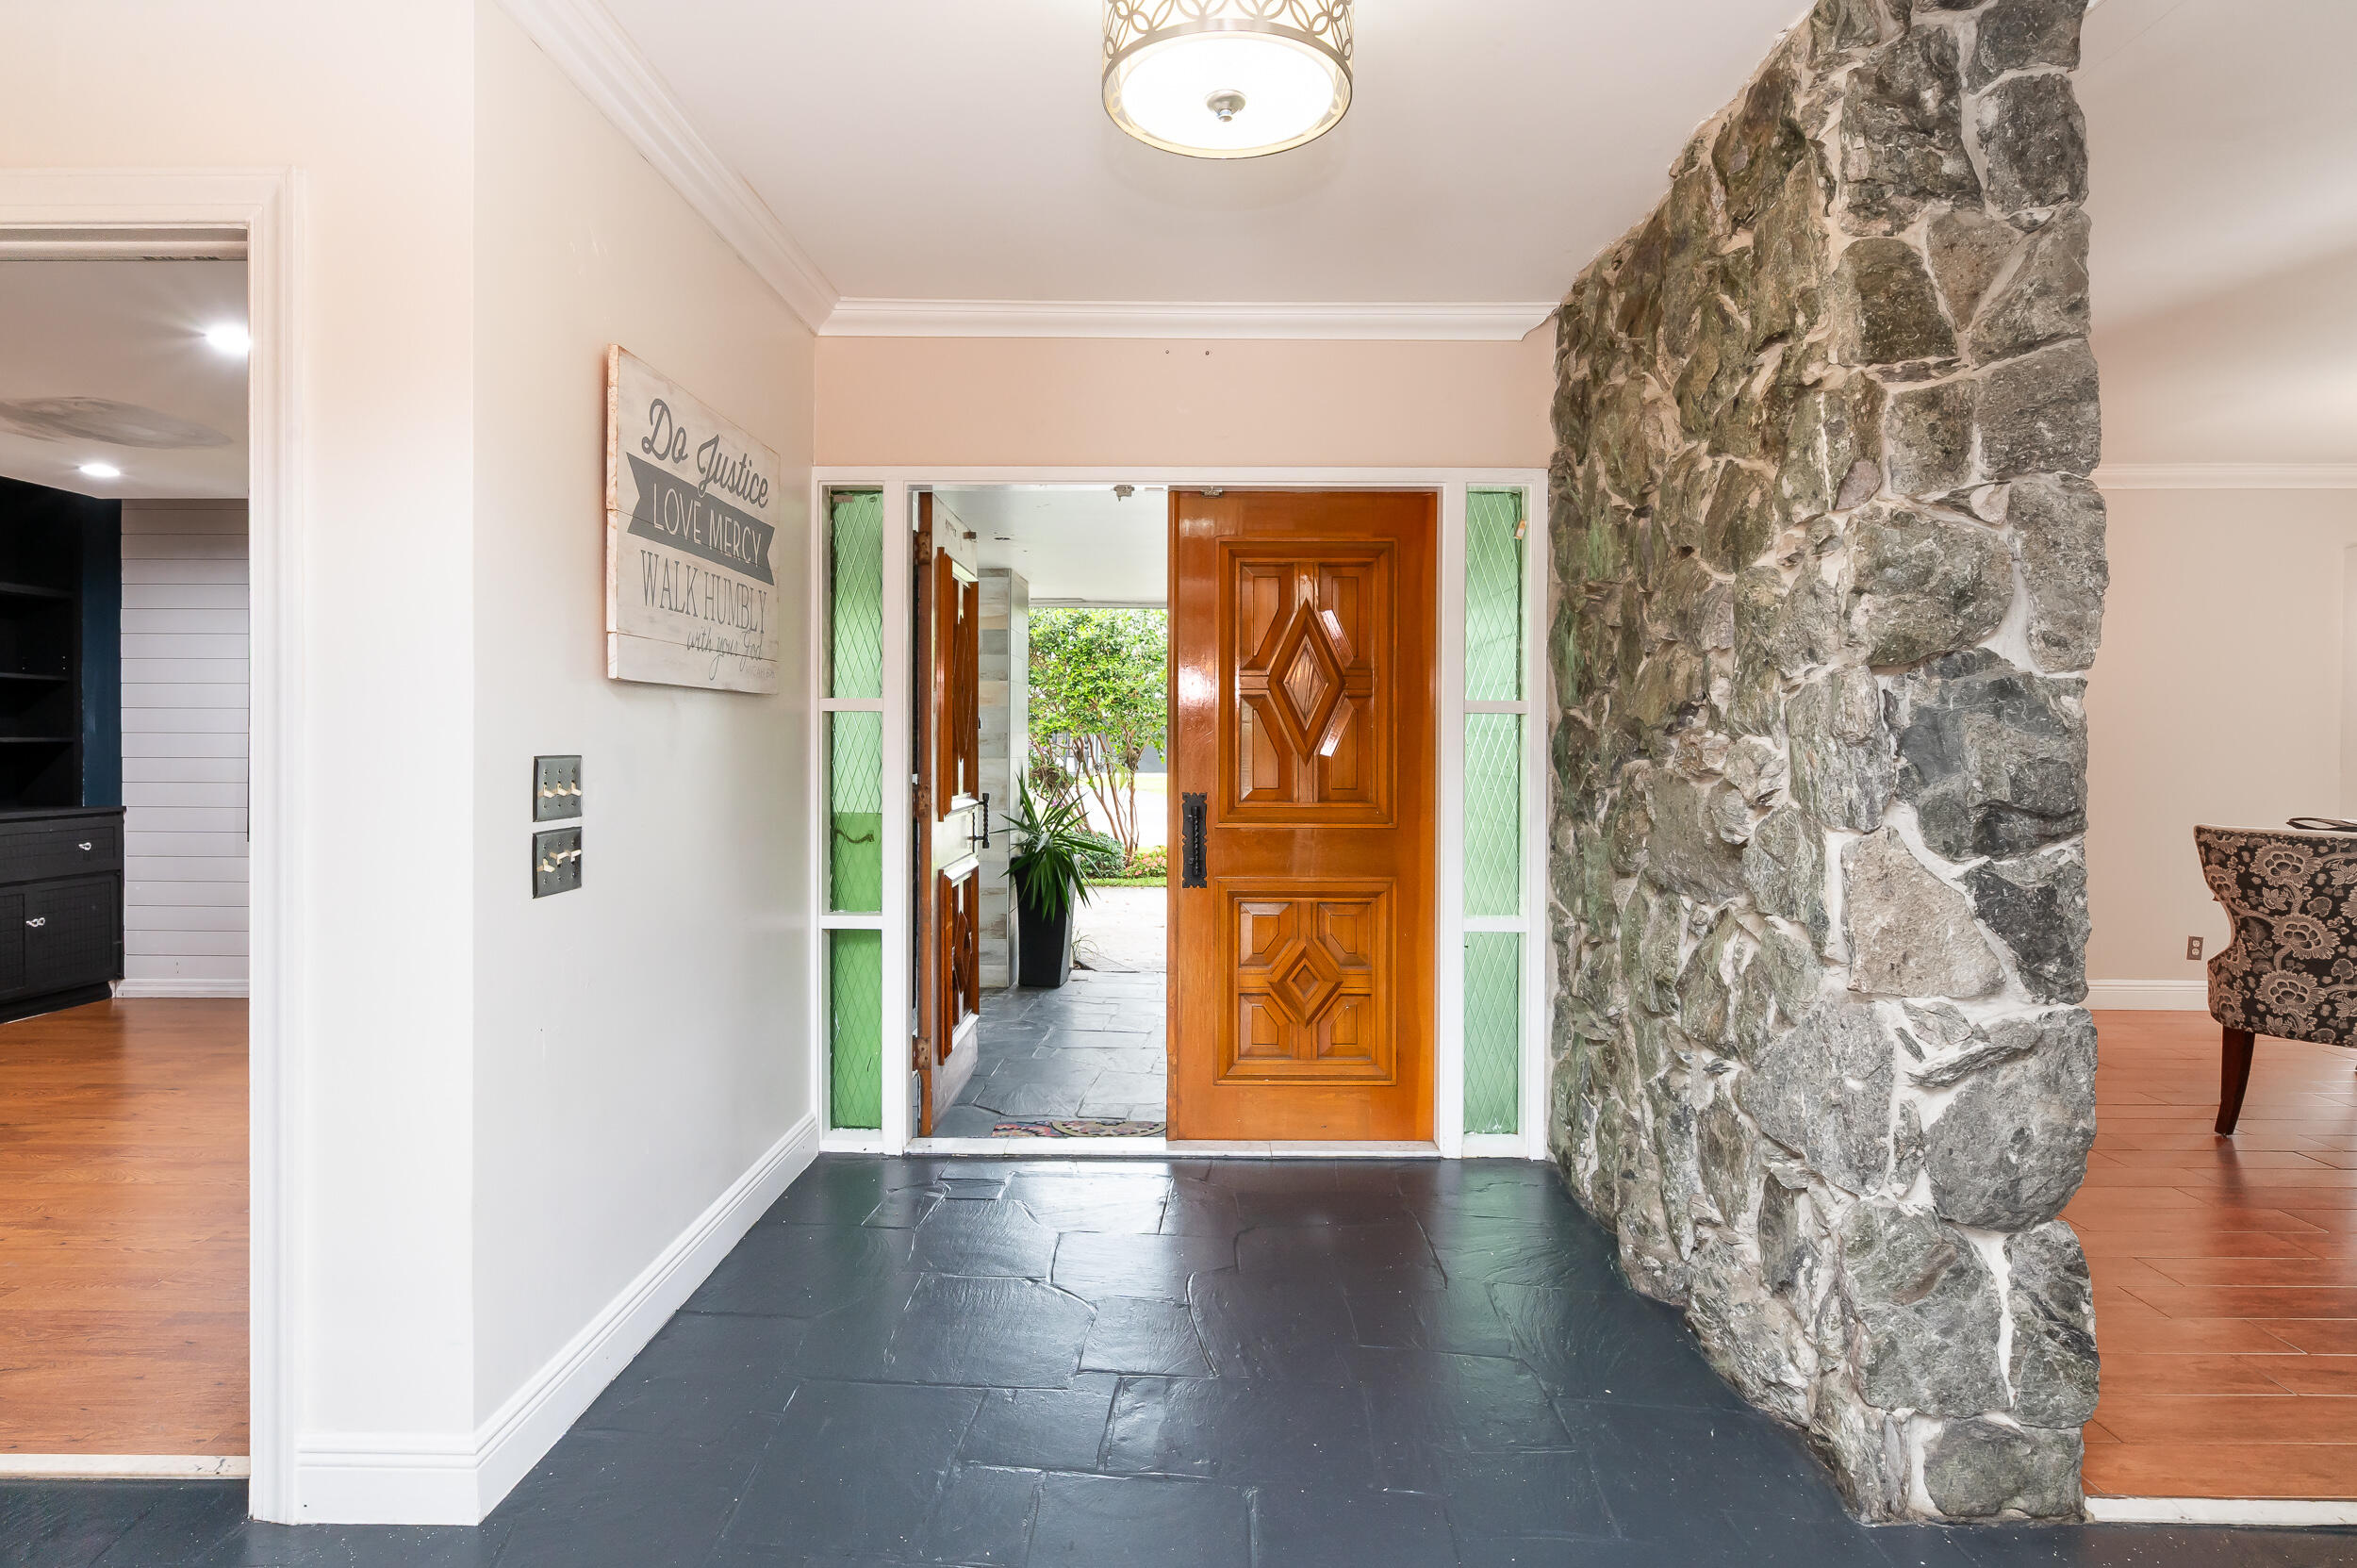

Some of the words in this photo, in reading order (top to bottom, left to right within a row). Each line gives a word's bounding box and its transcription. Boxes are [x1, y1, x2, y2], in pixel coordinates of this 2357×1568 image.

[641, 398, 688, 464] Do
[697, 434, 768, 509] Justice
[652, 482, 701, 545] LOVE
[709, 508, 762, 568] MERCY
[641, 549, 698, 618] WALK
[703, 571, 766, 635] HUMBLY
[686, 626, 713, 652] with
[709, 636, 738, 681] your
[739, 629, 764, 672] God
